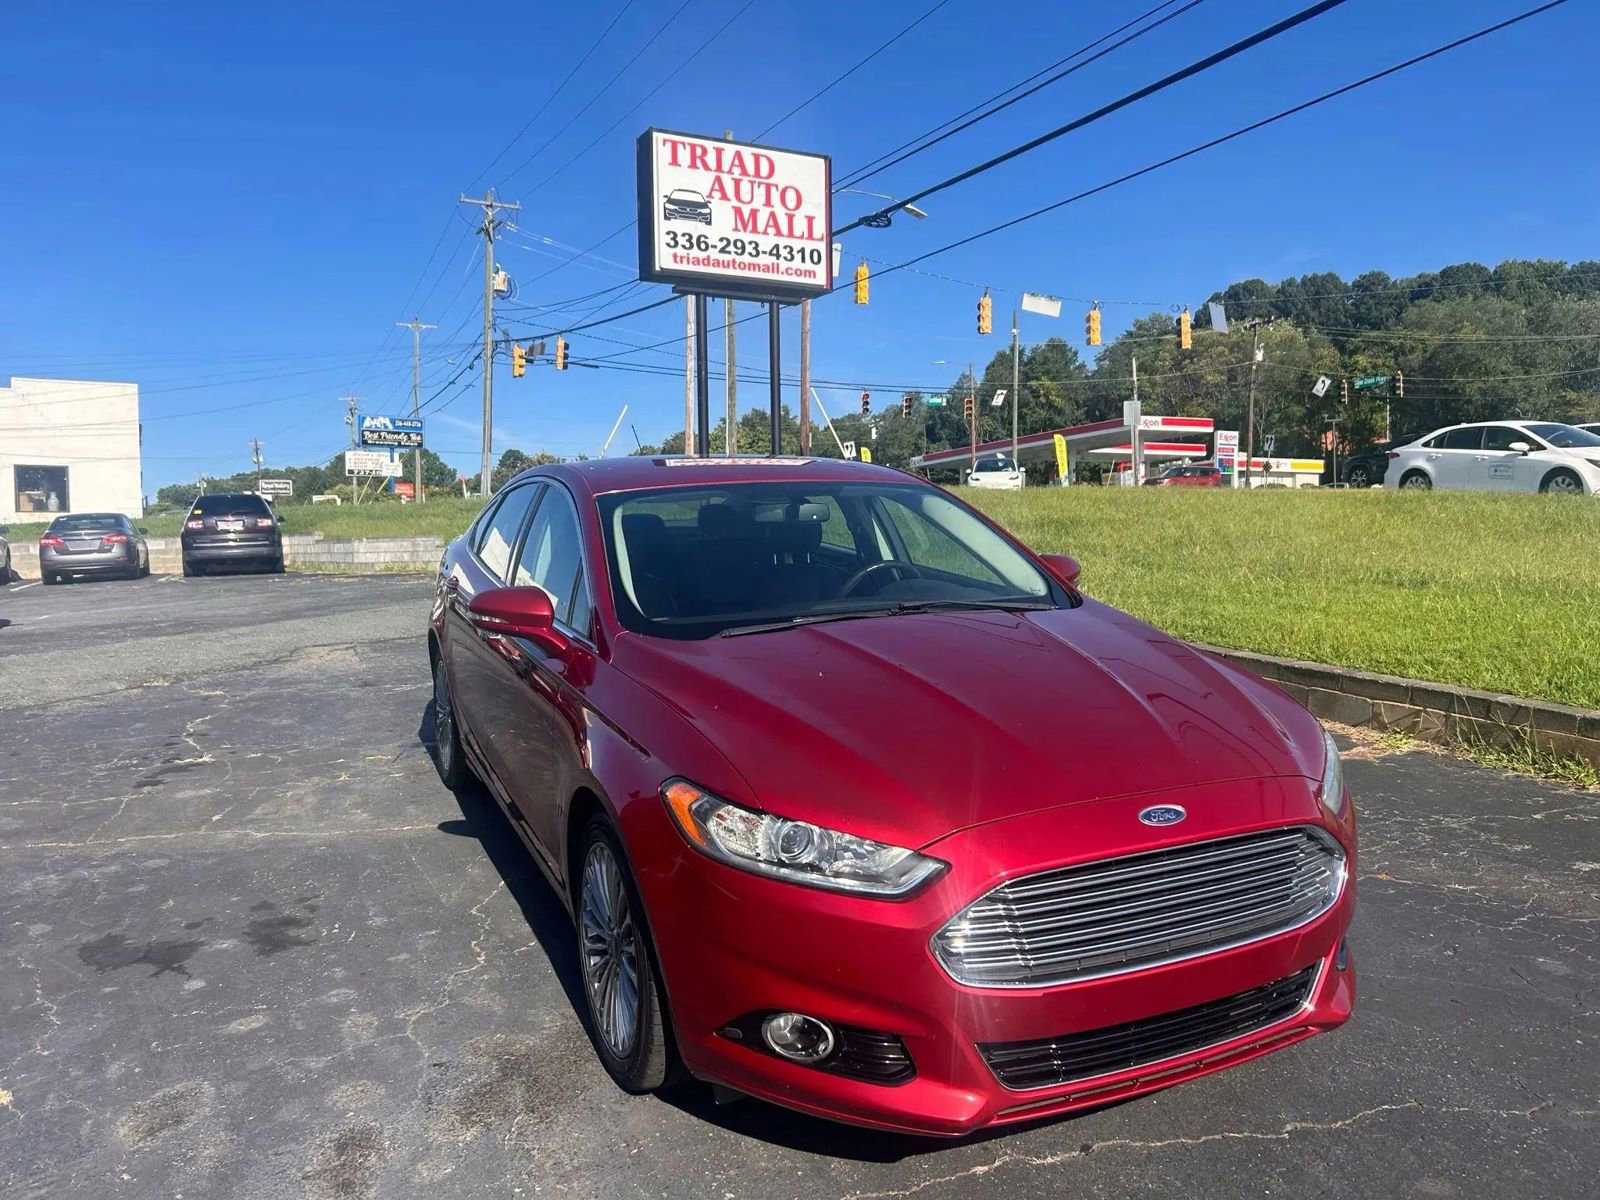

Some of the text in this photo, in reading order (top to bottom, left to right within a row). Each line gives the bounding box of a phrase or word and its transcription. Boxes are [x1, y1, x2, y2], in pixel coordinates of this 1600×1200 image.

[663, 138, 775, 180] TRIAD
[706, 175, 803, 211] AUTO
[731, 206, 824, 242] MALL
[665, 230, 822, 265] 336-293-4310
[672, 252, 817, 279] triadautomall.com
[1141, 417, 1159, 428] xxon
[1219, 433, 1237, 442] Exxon
[1151, 809, 1176, 821] Ford
